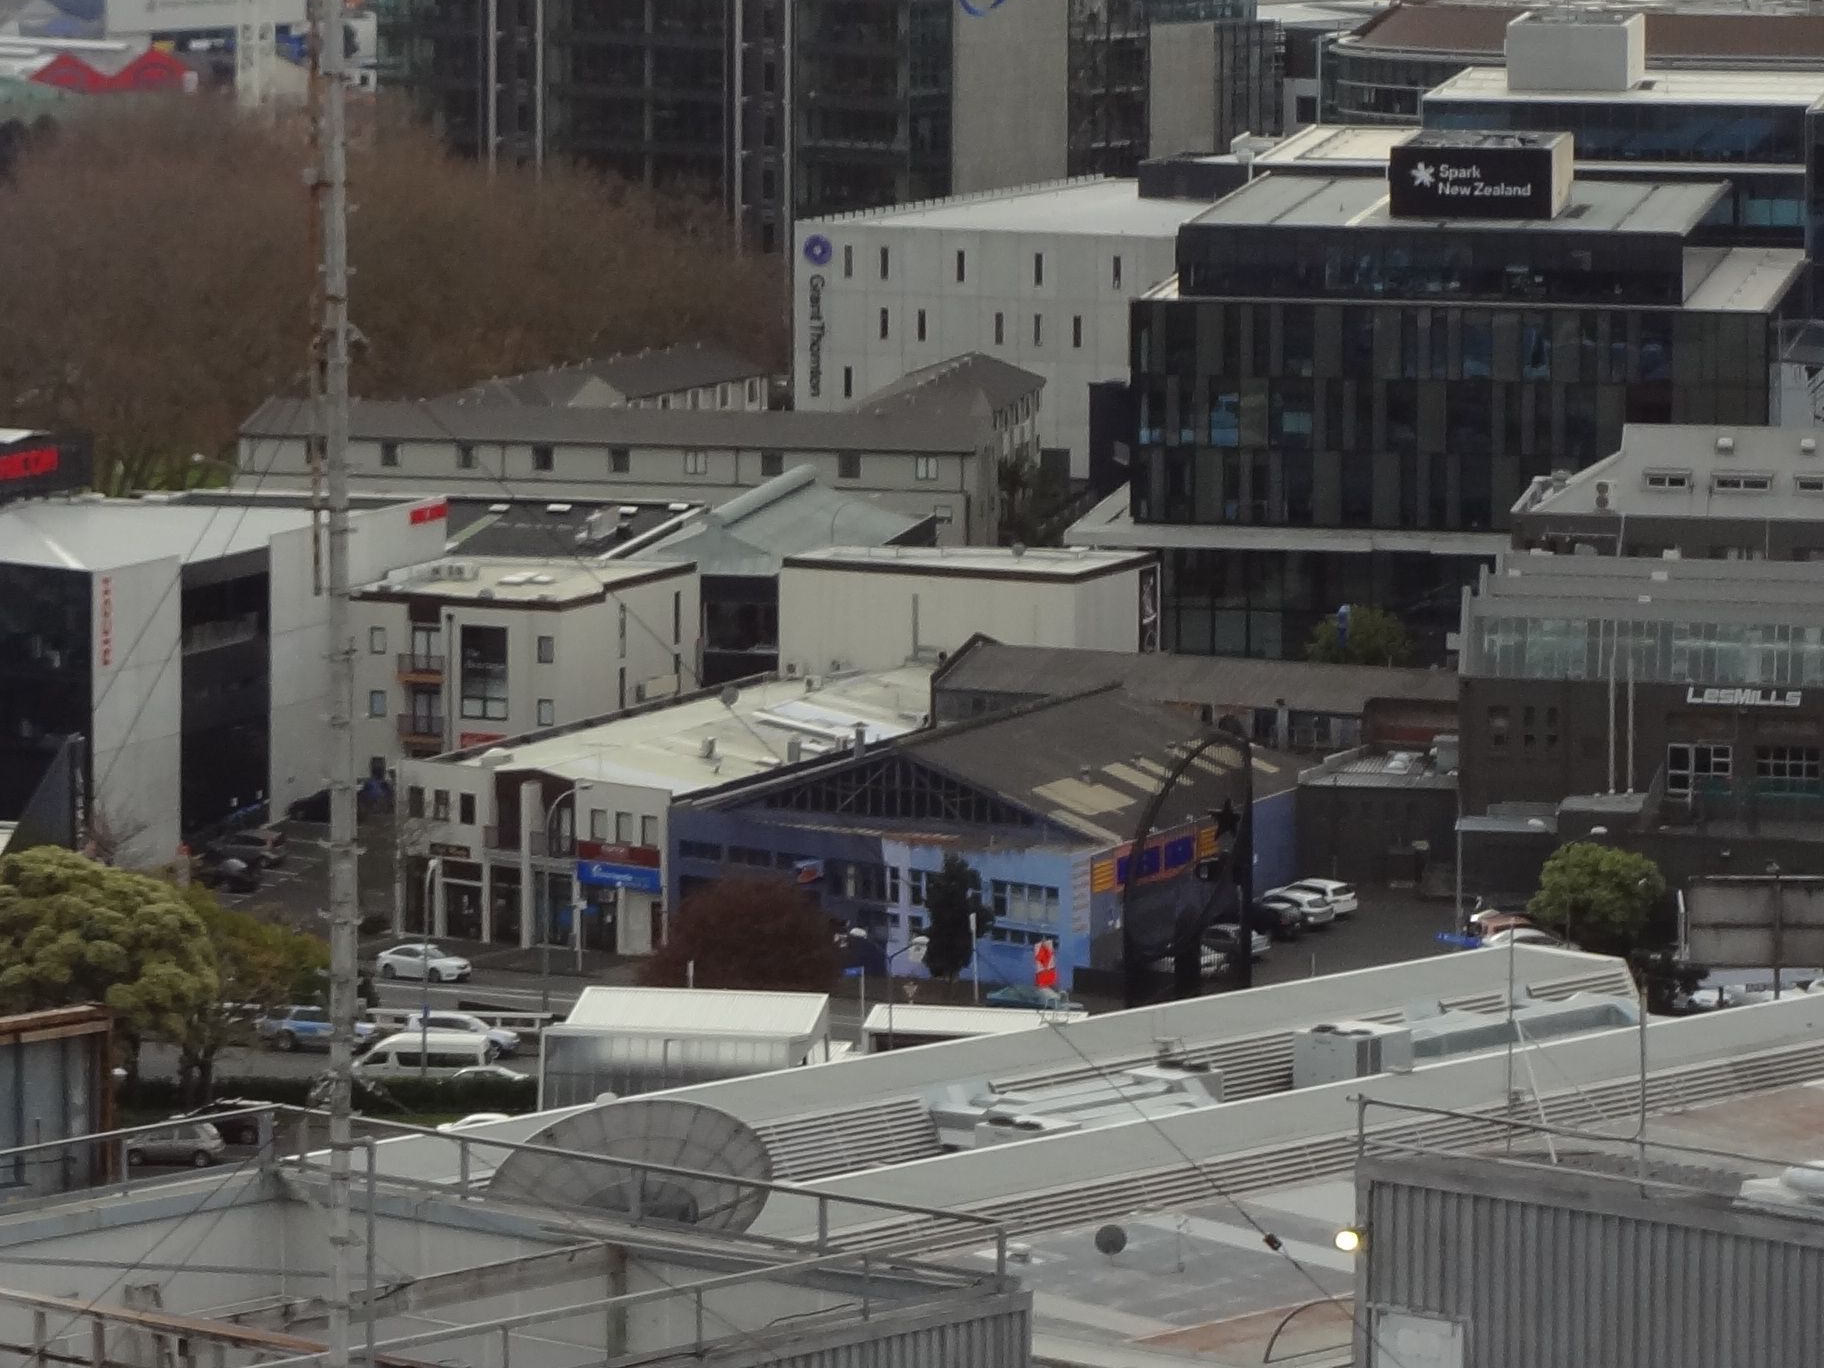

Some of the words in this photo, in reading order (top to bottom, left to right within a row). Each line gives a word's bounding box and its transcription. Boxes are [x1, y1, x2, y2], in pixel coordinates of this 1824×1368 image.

[1439, 164, 1481, 180] Spark
[1438, 182, 1472, 195] New
[1474, 182, 1532, 196] Zealand
